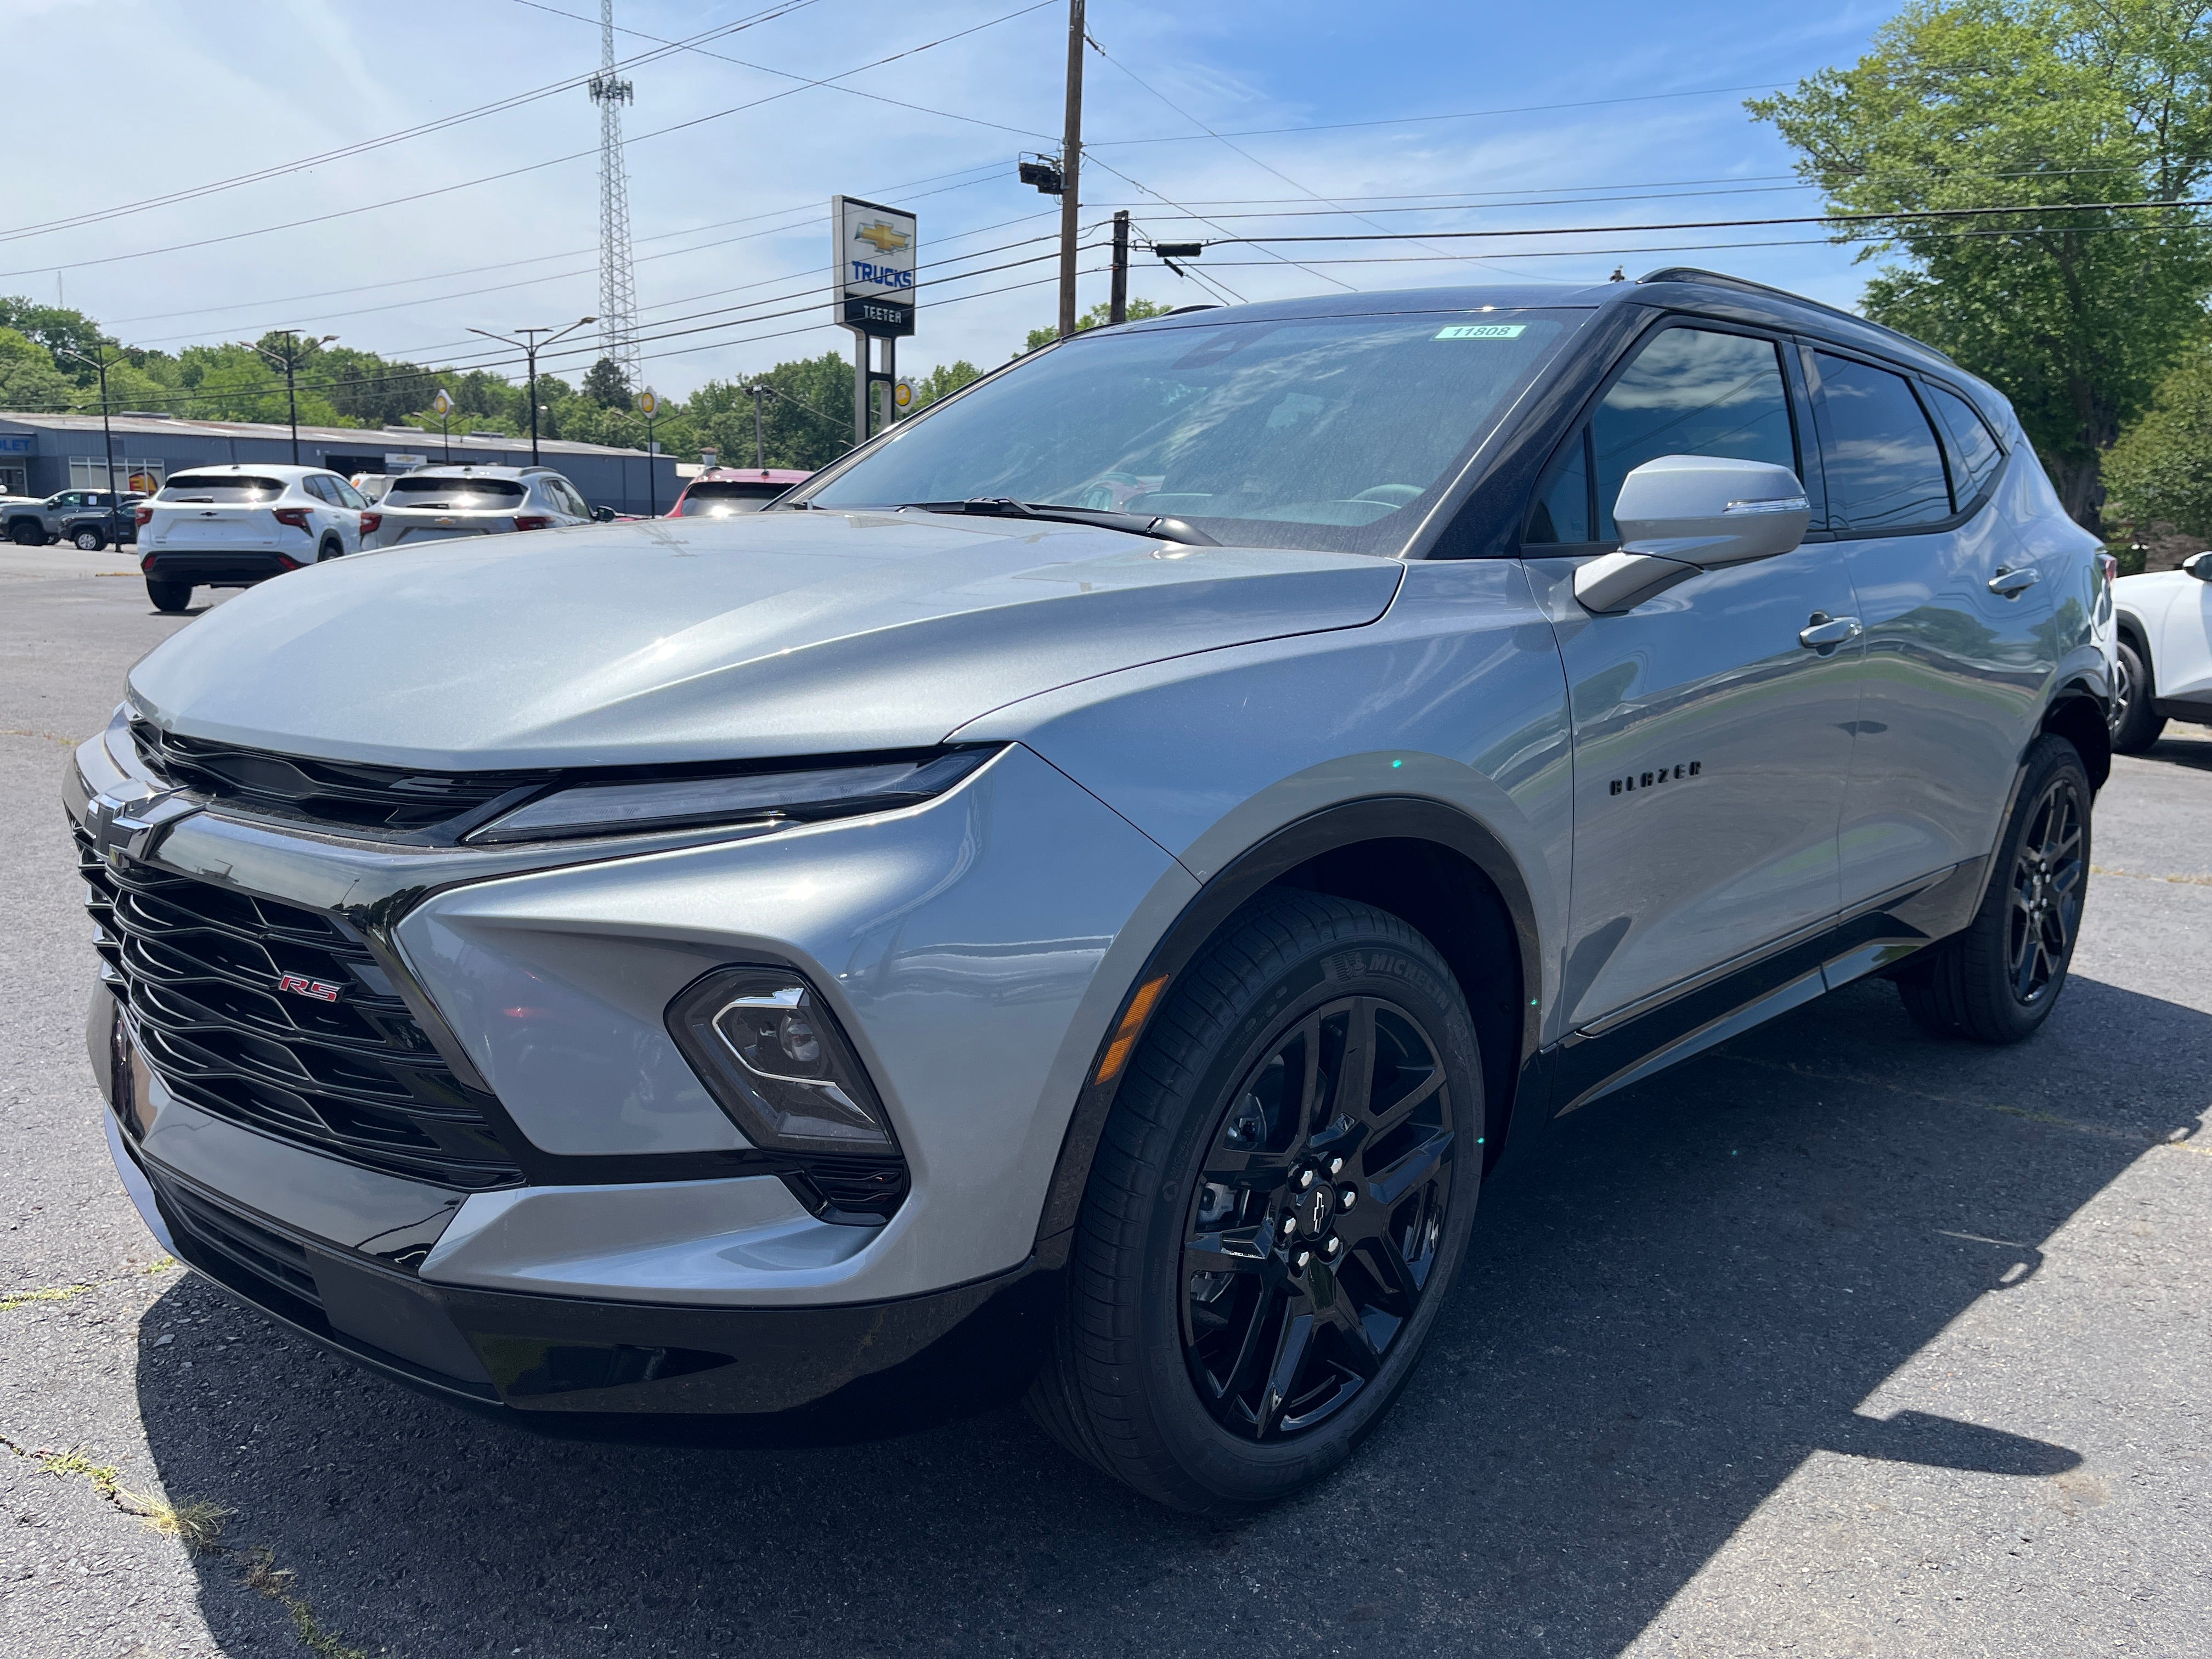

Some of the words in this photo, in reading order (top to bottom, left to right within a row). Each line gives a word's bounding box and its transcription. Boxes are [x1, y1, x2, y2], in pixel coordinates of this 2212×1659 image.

[852, 261, 912, 289] TRUCKS
[863, 305, 901, 324] TEETER
[1453, 327, 1511, 336] 11808
[1609, 760, 1702, 795] BLAZER
[279, 975, 341, 1002] RS
[1368, 954, 1451, 1011] MICHELIN
